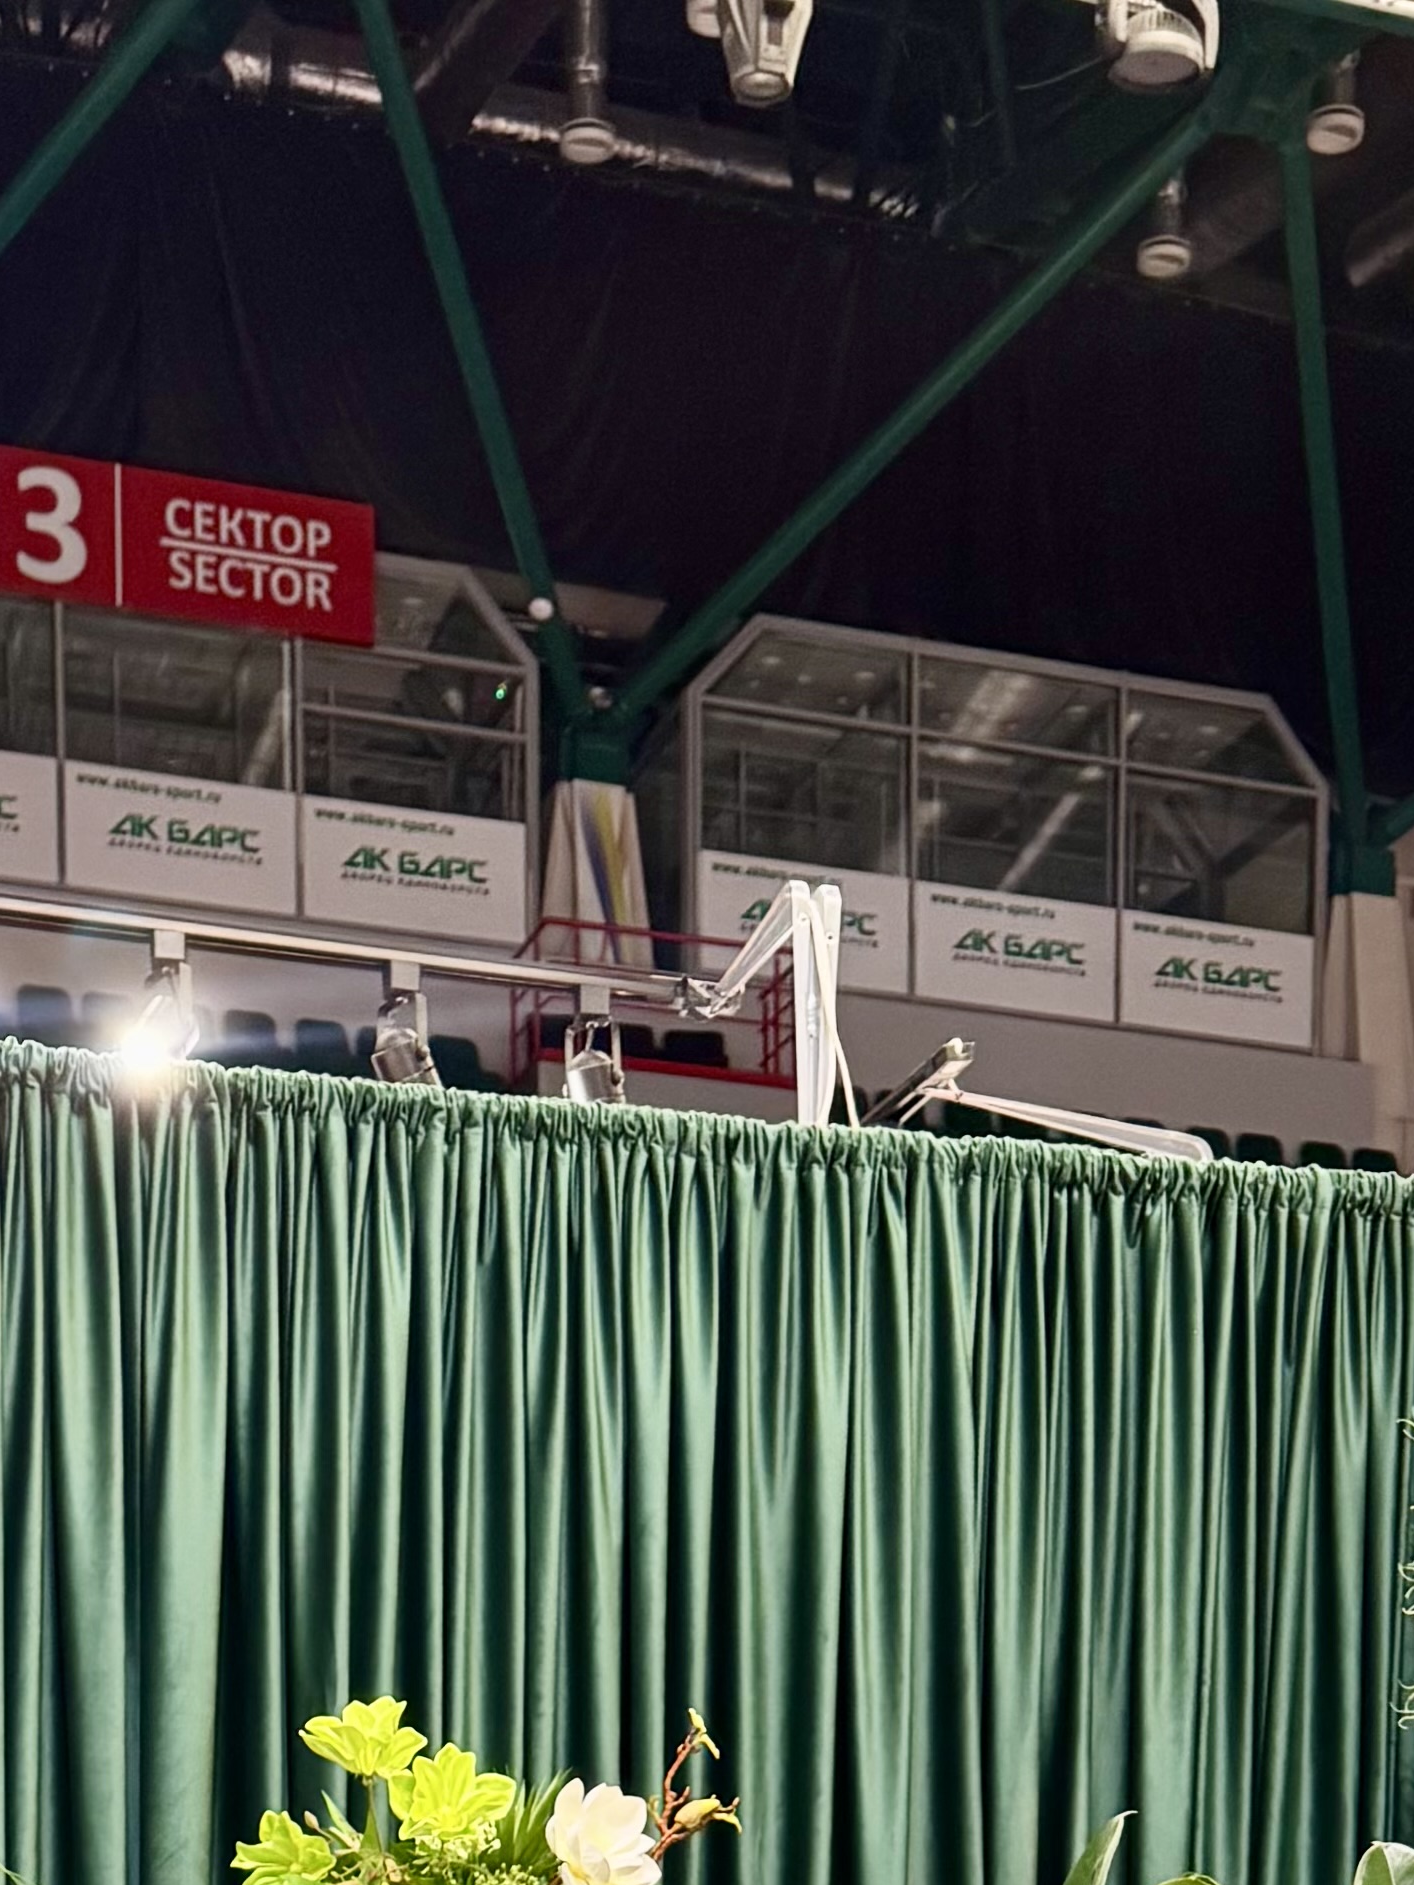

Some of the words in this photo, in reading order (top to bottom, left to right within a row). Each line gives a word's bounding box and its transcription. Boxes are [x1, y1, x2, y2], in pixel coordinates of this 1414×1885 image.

[16, 465, 88, 585] 3
[164, 499, 332, 557] СЕКТОР
[168, 551, 332, 612] SECTOR
[109, 812, 160, 841] АК
[167, 818, 262, 854] БАРС
[342, 845, 391, 872] АК
[397, 851, 490, 884] БАРС
[953, 927, 997, 954] АК
[1003, 934, 1084, 965] БАРС
[1155, 956, 1198, 981] АК
[1202, 961, 1283, 992] БАРС
